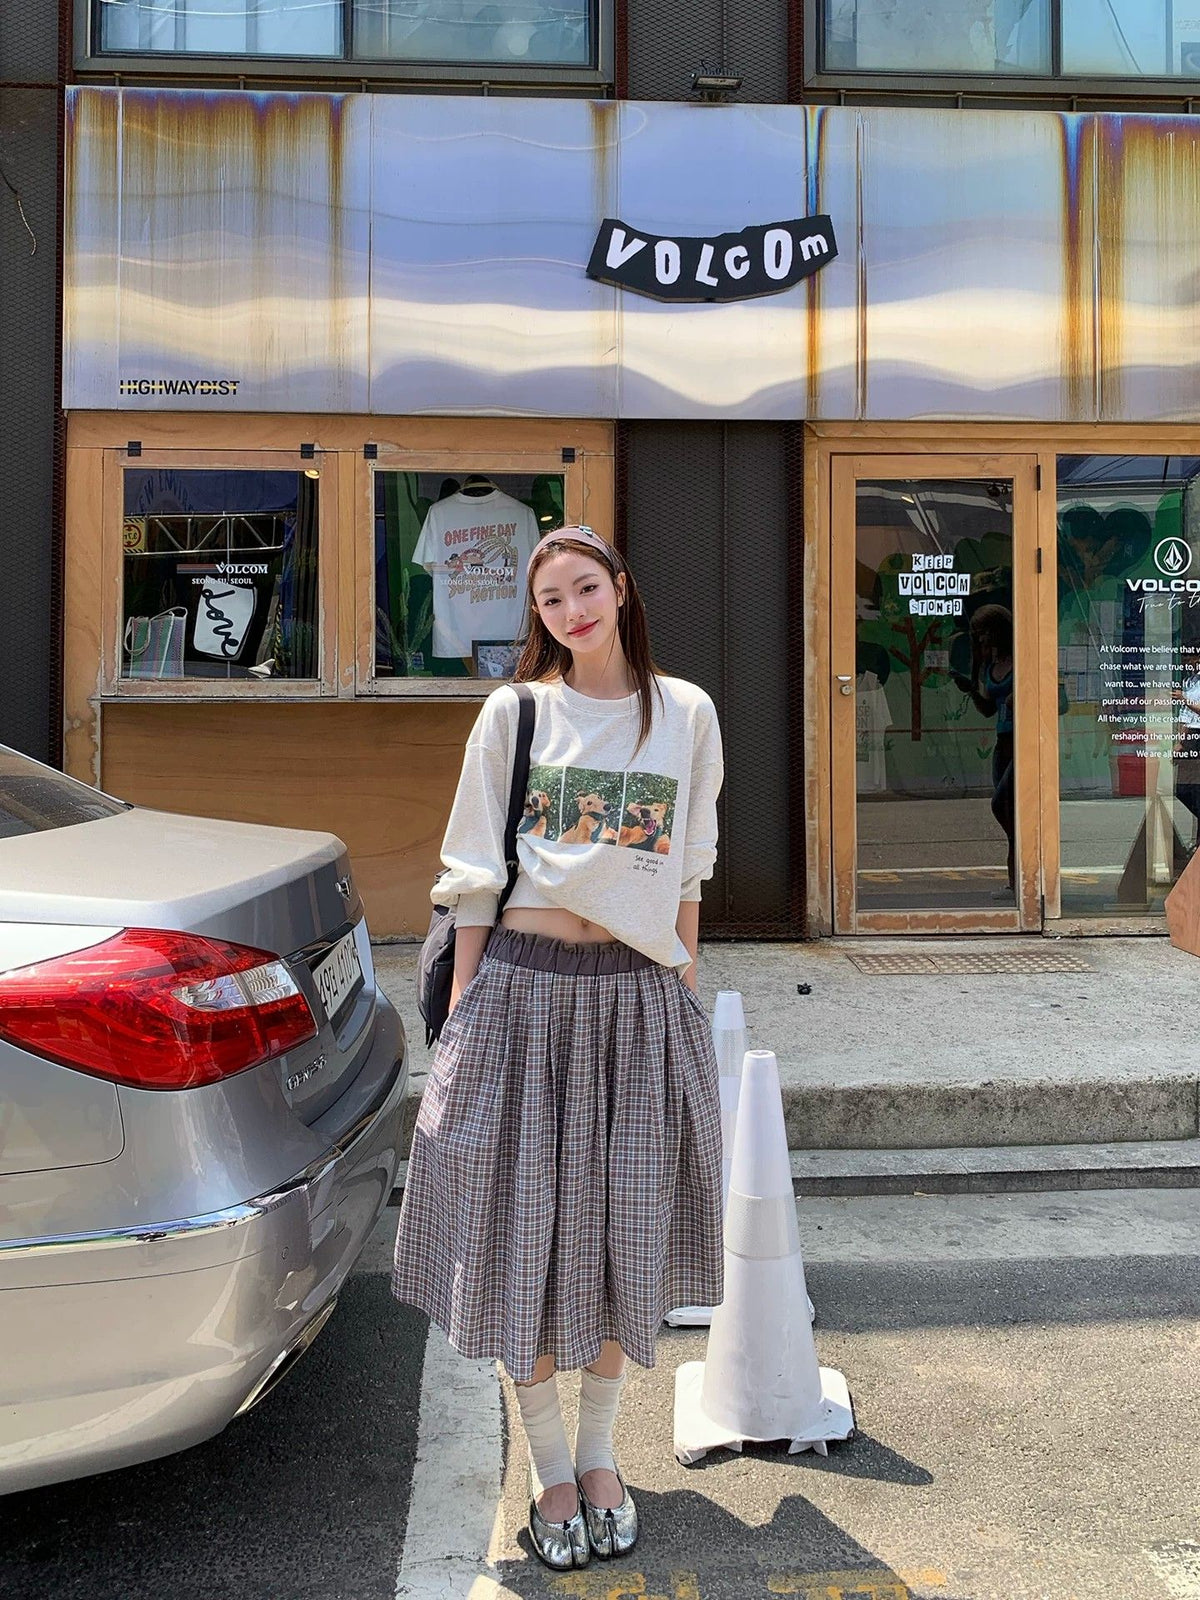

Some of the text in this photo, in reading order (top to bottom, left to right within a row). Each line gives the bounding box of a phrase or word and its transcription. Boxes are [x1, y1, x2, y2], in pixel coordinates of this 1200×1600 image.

[120, 380, 240, 395] HIGHWAYDIST
[444, 523, 517, 547] ONE FINE DAY
[216, 562, 268, 574] VOLCOM
[913, 555, 952, 569] KEEP
[463, 564, 513, 576] VOLCOM
[900, 575, 969, 593] VOLCOM
[1126, 579, 1200, 592] VOLCO
[470, 585, 518, 604] MOTION
[911, 600, 961, 614] STONED
[1100, 645, 1108, 653] At
[1110, 645, 1138, 653] Volcom
[1151, 646, 1178, 654] believe
[1180, 646, 1196, 654] that
[1099, 663, 1121, 671] chase
[1168, 663, 1184, 671] true
[1152, 680, 1171, 688] have
[1102, 697, 1128, 706] pursuit
[1130, 697, 1138, 705] of
[1153, 698, 1185, 707] passions
[1122, 716, 1138, 724] way
[1149, 715, 1162, 723] the
[1111, 733, 1148, 742] reshaping
[1149, 733, 1162, 741] the
[1163, 733, 1185, 741] world
[1173, 750, 1189, 758] true
[1190, 749, 1198, 757] to
